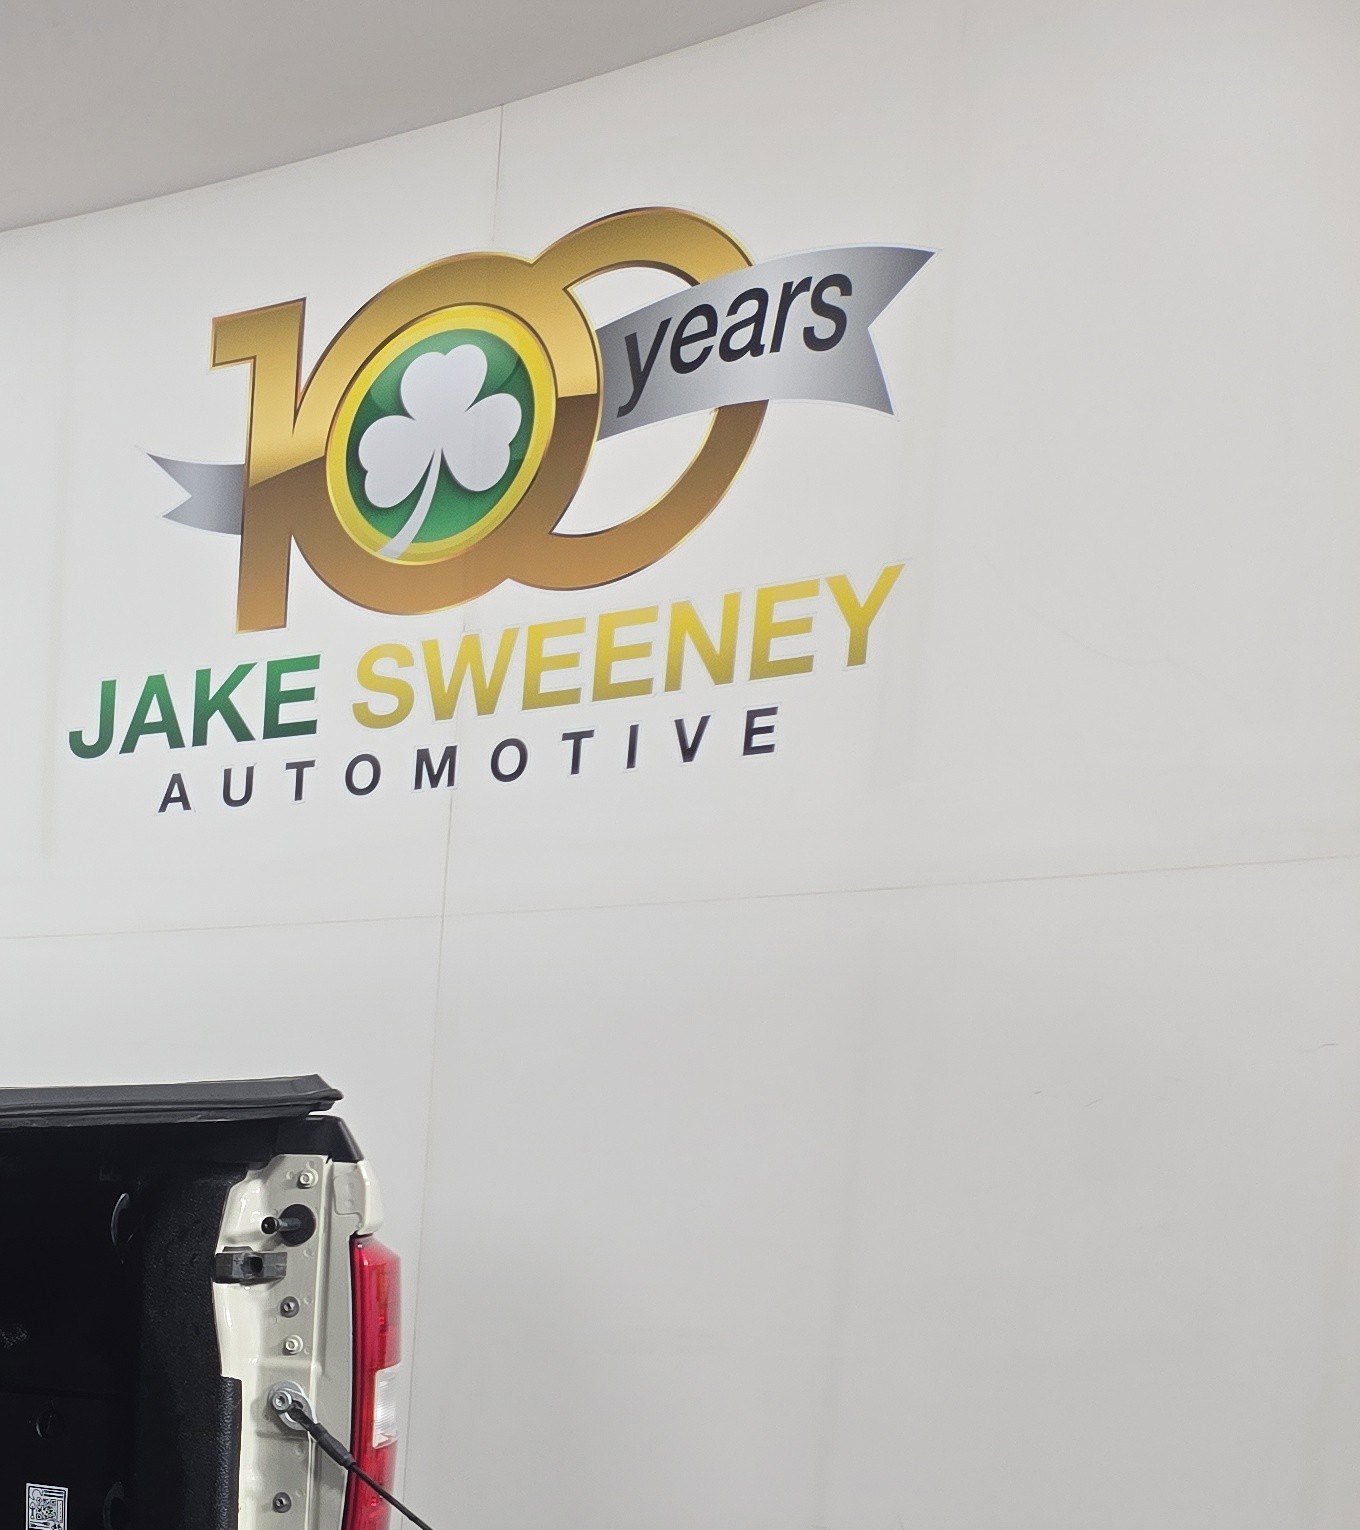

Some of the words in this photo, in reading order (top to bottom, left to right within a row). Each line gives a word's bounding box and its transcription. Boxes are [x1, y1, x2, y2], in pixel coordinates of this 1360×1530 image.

[616, 270, 854, 420] years
[68, 653, 322, 760] JAKE
[351, 563, 907, 731] SWEENEY
[157, 706, 782, 815] AUTOMOTIVE
